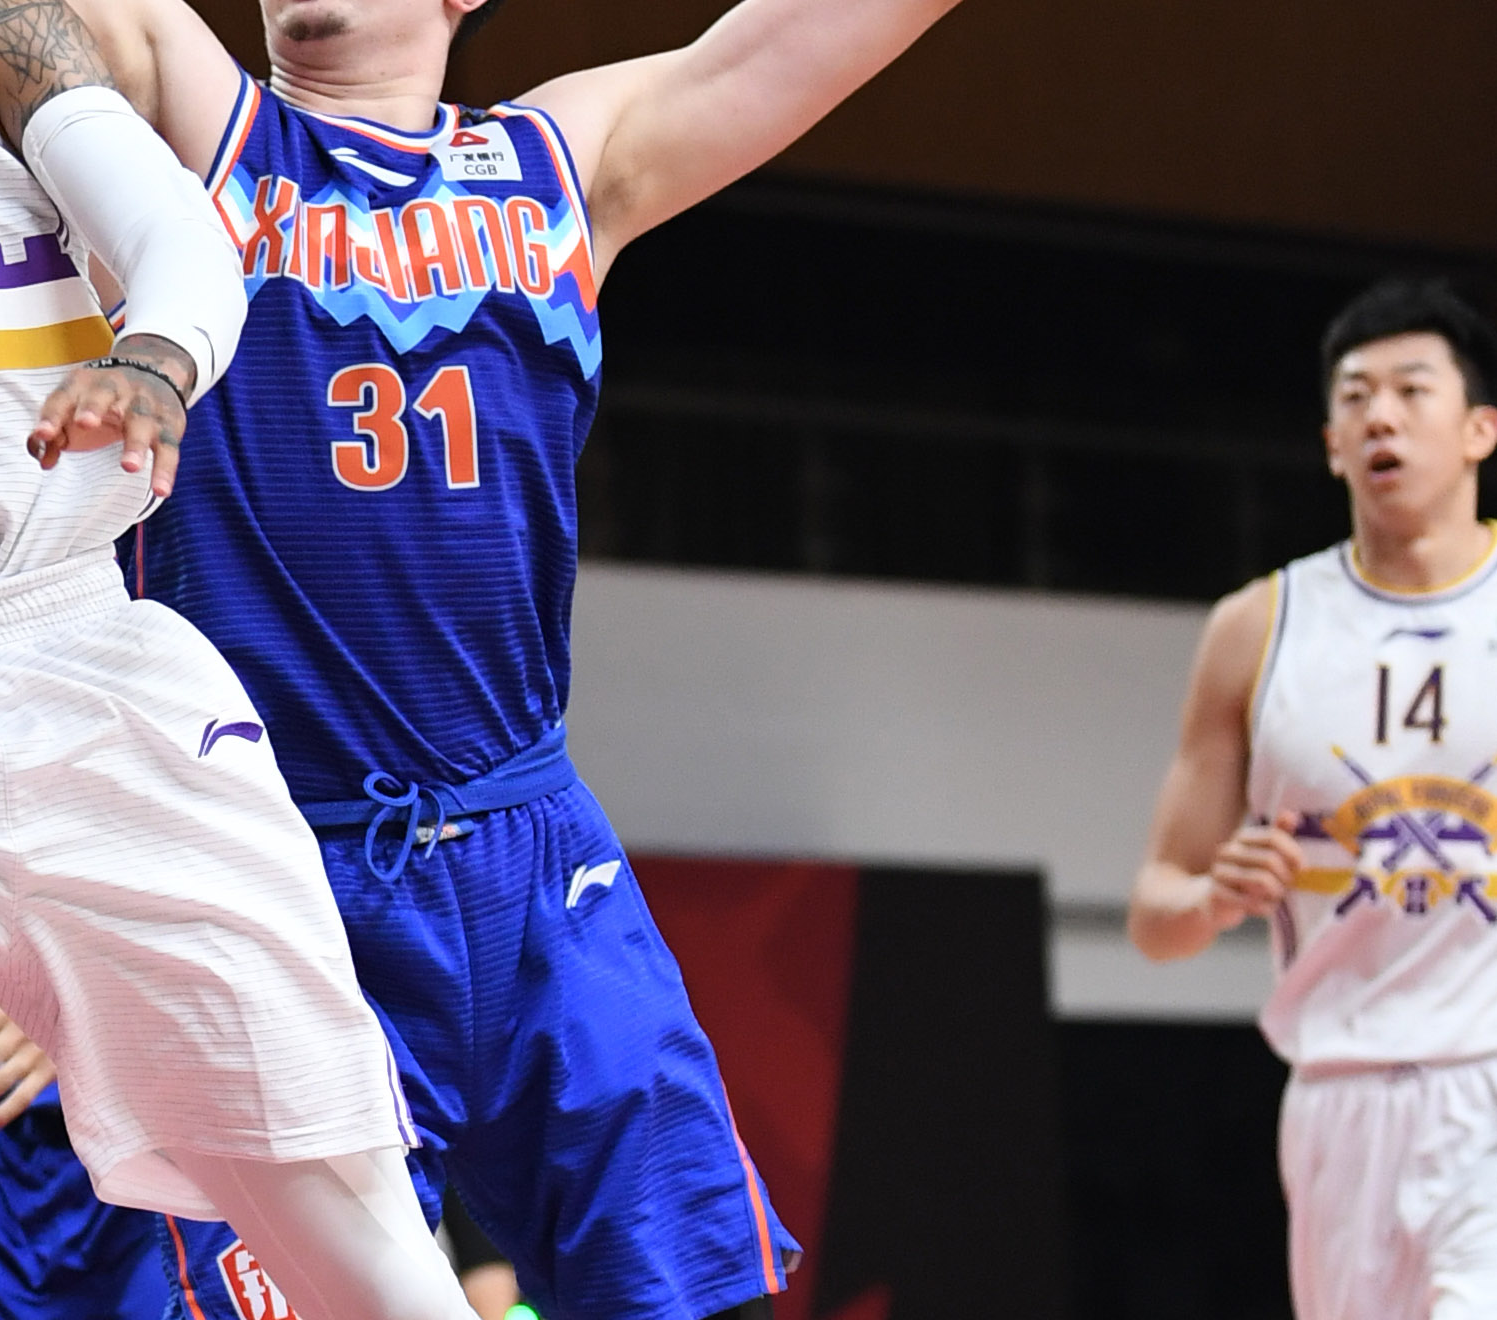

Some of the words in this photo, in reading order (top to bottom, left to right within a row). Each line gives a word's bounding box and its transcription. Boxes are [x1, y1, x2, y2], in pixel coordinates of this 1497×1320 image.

[464, 164, 498, 175] CGB
[327, 363, 480, 492] 31
[1374, 663, 1448, 745] 14
